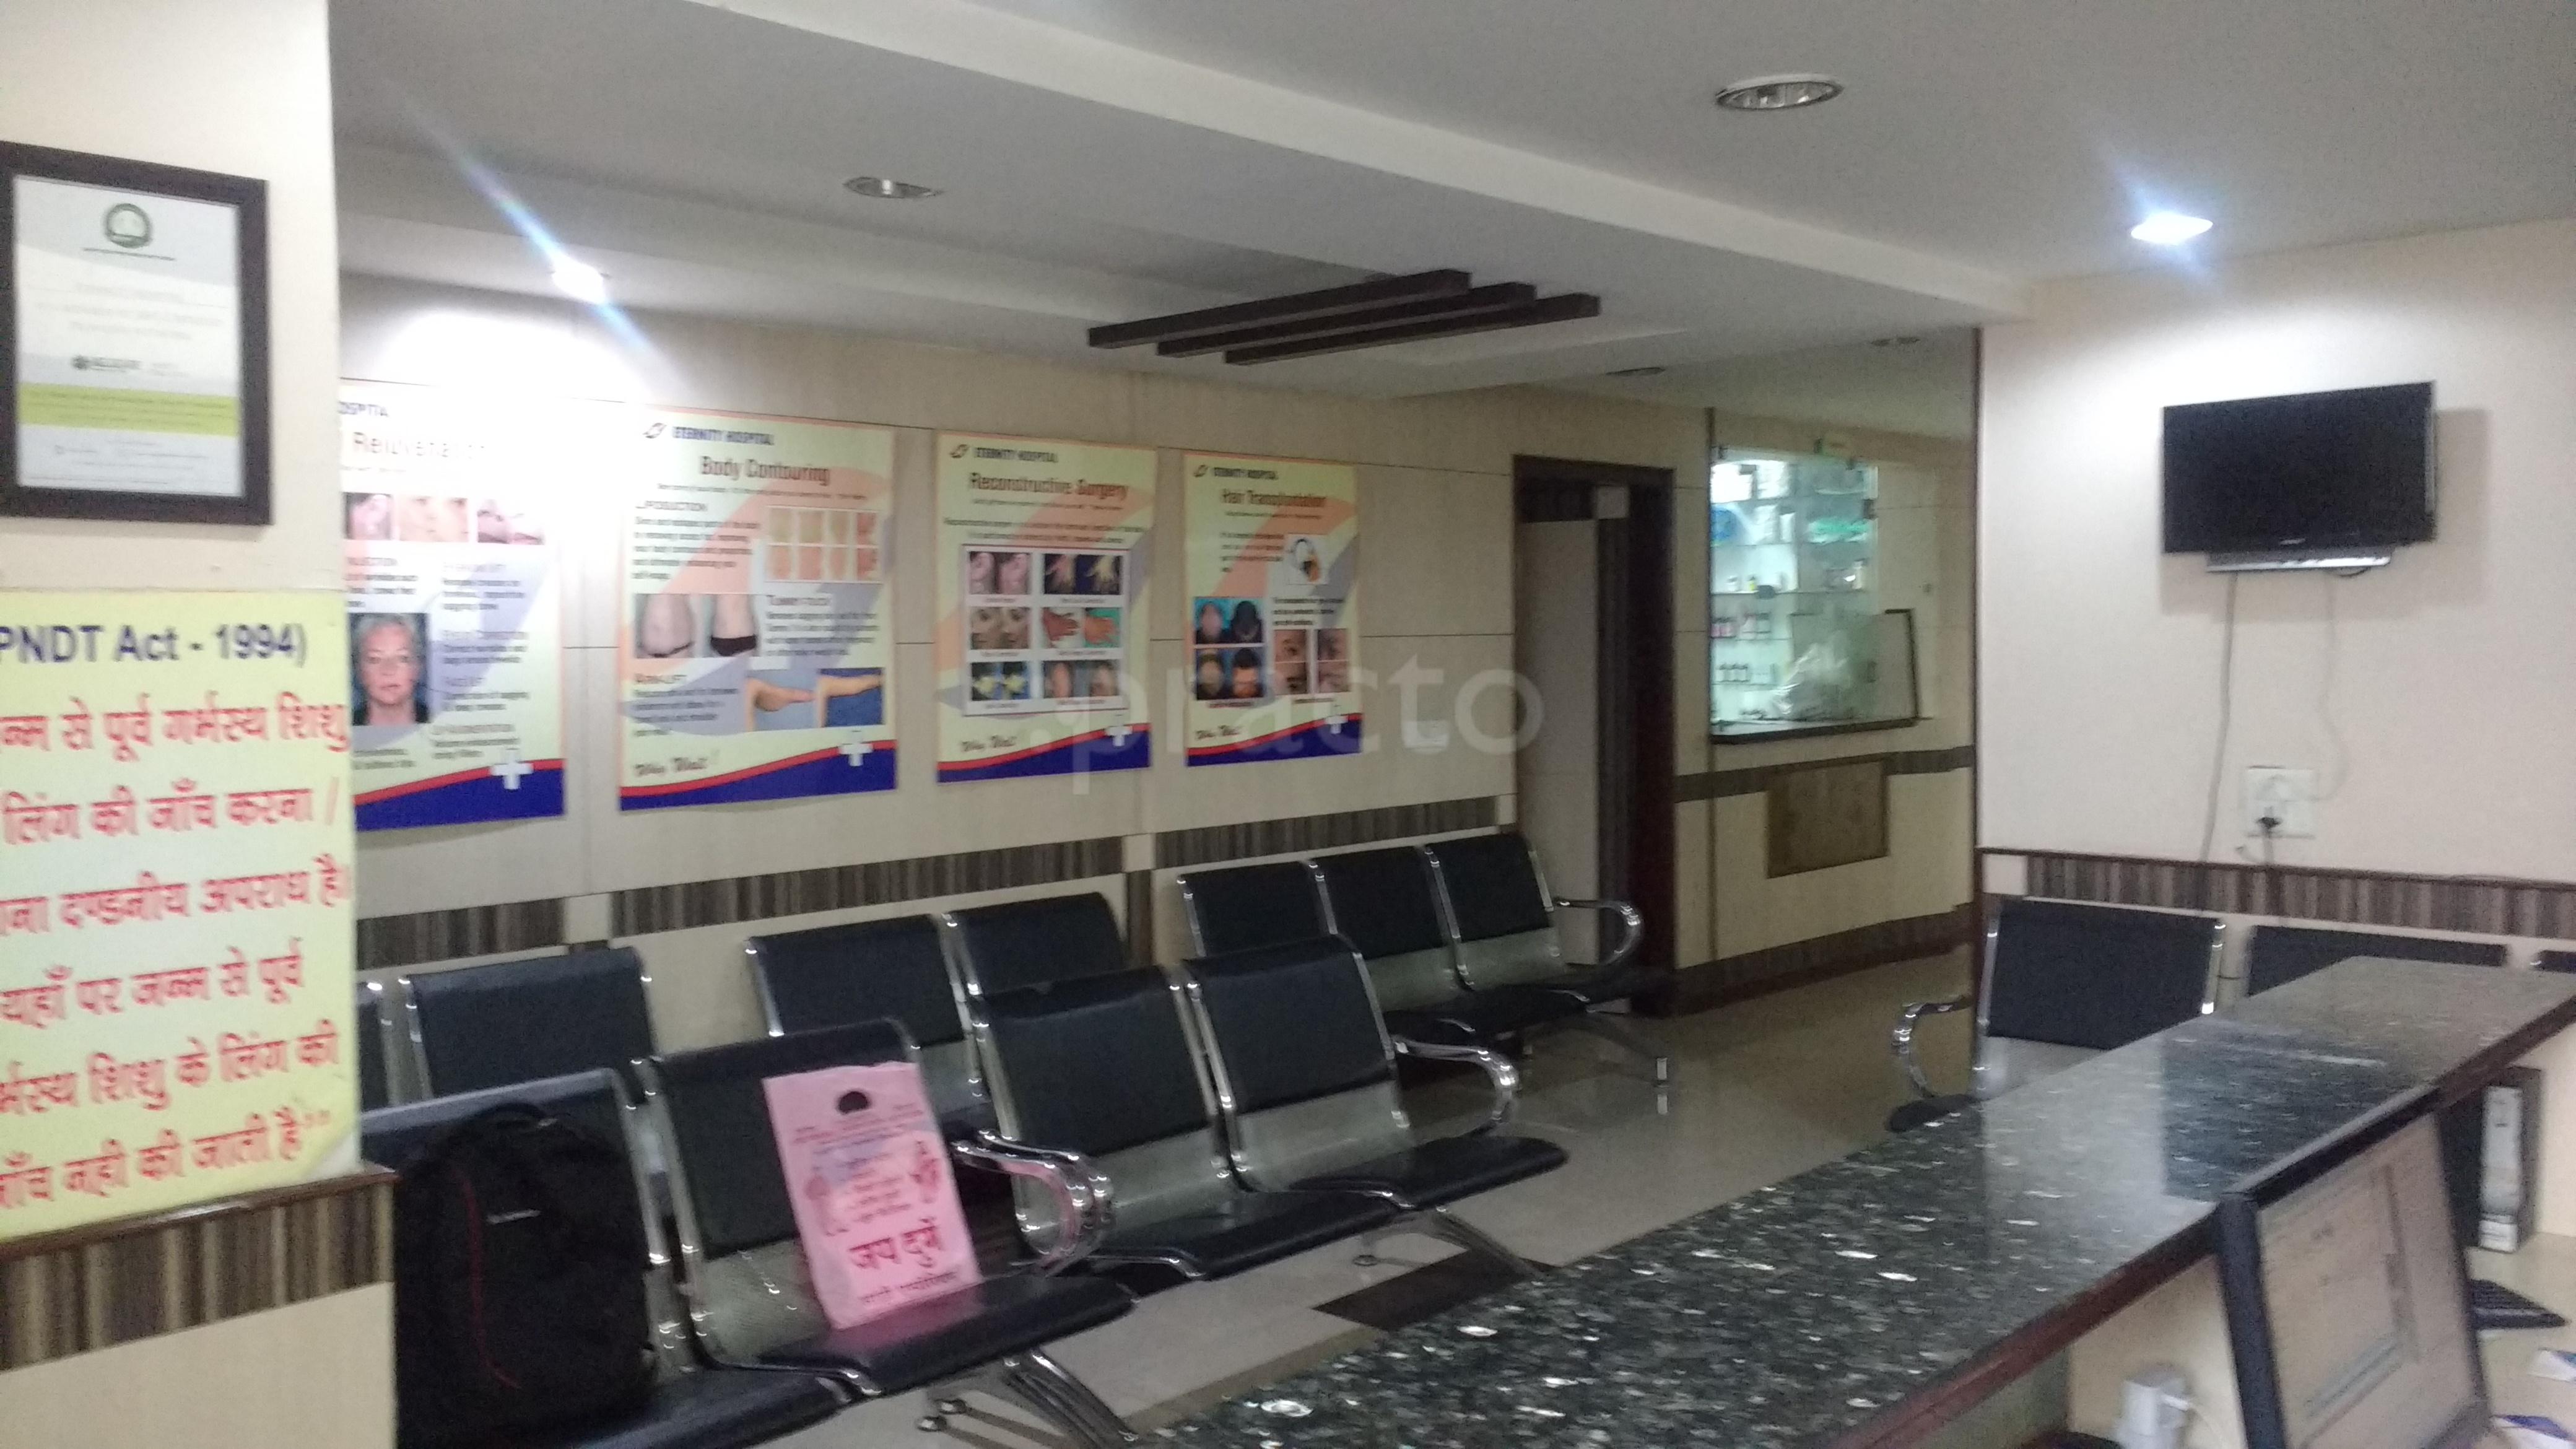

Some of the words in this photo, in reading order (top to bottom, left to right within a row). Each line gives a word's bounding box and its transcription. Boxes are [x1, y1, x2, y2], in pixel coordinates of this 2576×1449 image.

[672, 426, 722, 442] ETERNITY
[726, 430, 774, 445] HOSPITAL
[700, 455, 741, 481] Body
[745, 458, 830, 486] Contouring
[969, 472, 1073, 495] Reconstructive
[1076, 479, 1128, 502] Surgery
[1221, 489, 1245, 504] Hair
[113, 624, 180, 663] Act
[214, 622, 308, 668] 1994)
[60, 695, 95, 751] से
[102, 692, 153, 763] पूर्व
[89, 784, 139, 837] की
[225, 788, 314, 826] करना
[199, 870, 311, 915] अपराध
[75, 977, 124, 1016] पर
[130, 965, 211, 1007] जन्म
[217, 944, 251, 998] से
[256, 936, 305, 1005] पूर्व
[174, 1037, 211, 1087] के
[215, 1032, 290, 1084] लिंग
[295, 1017, 341, 1068] की
[136, 1128, 186, 1178] की
[191, 1112, 272, 1170] जाती
